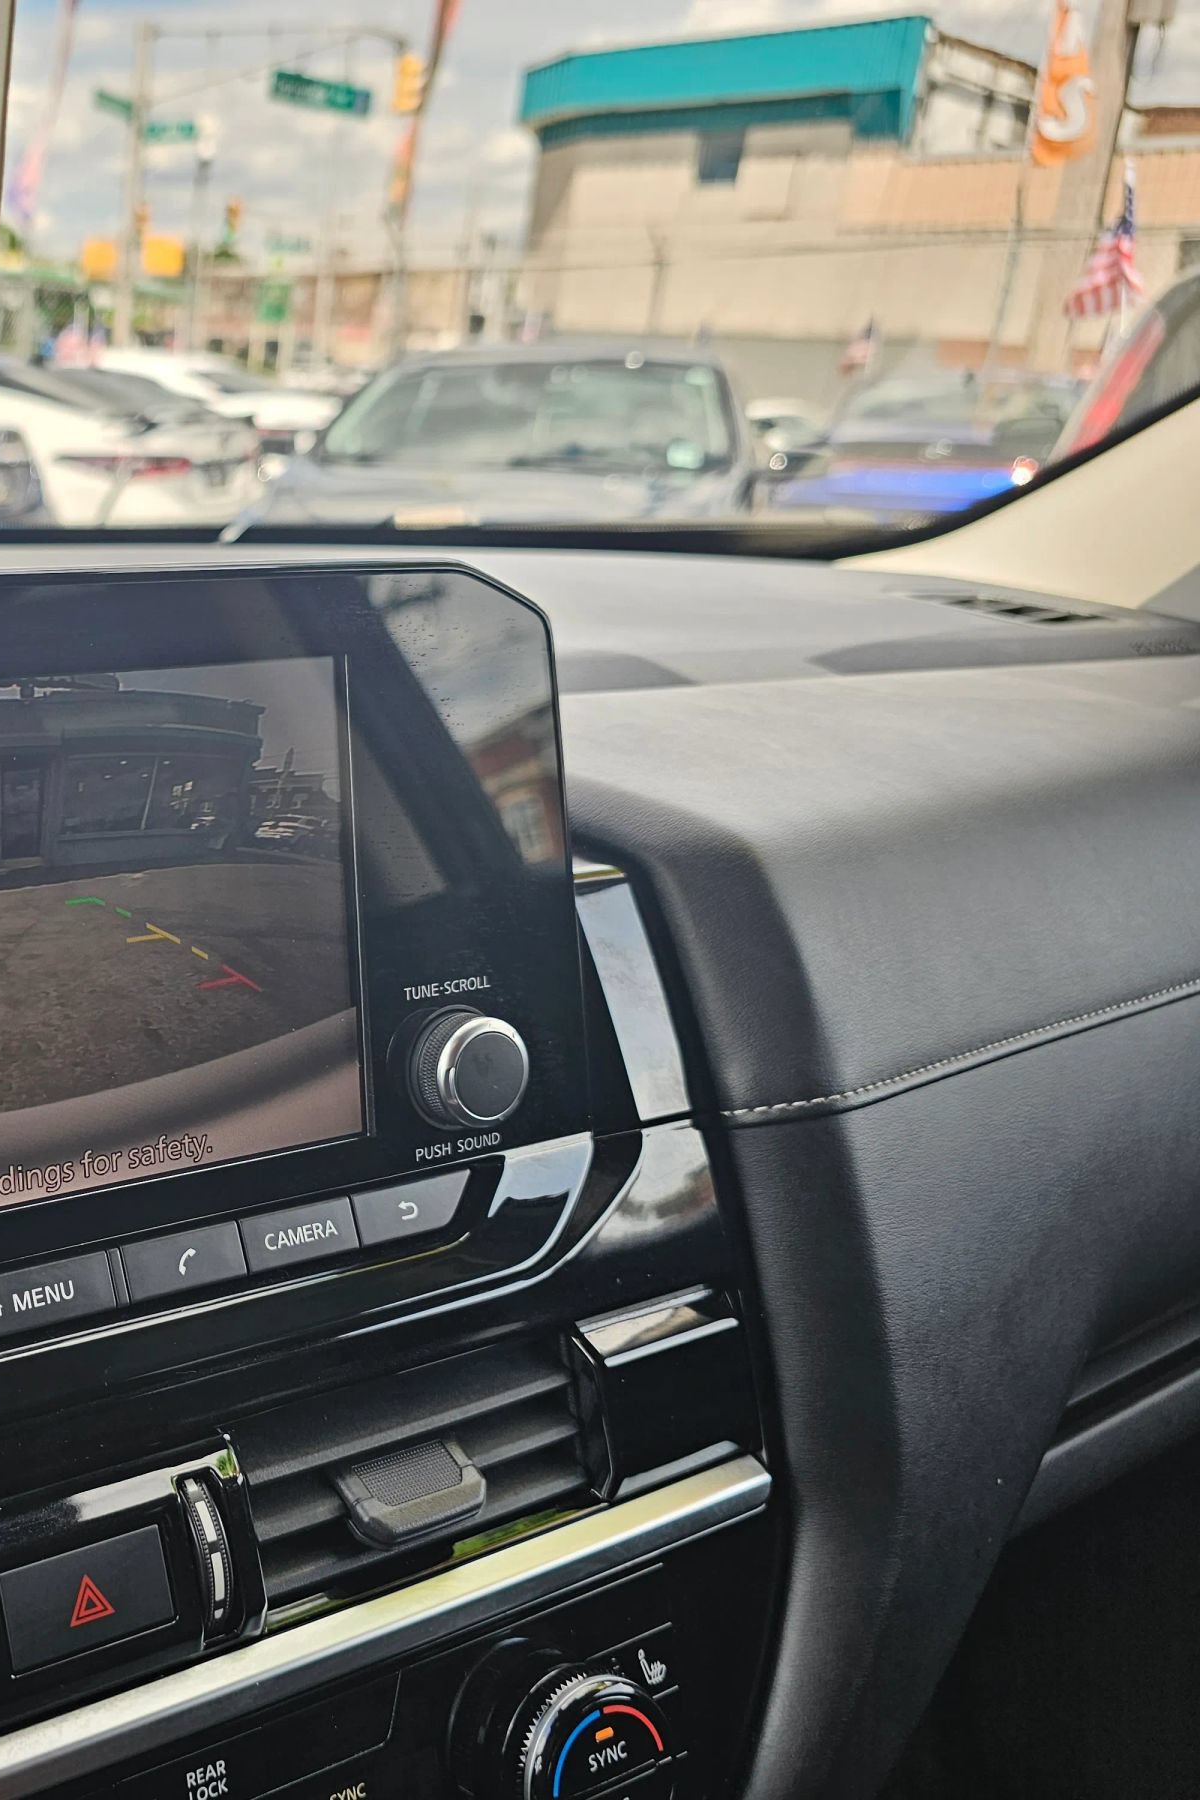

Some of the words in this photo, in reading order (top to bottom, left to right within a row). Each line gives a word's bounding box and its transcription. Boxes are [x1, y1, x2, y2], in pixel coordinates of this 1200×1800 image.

[403, 975, 491, 1001] TUNE-SCROLL
[79, 1149, 123, 1180] for
[127, 1132, 214, 1170] safety.
[415, 1142, 452, 1162] PUSH
[457, 1131, 501, 1154] SOUND
[263, 1218, 338, 1251] CAMERA
[11, 1278, 75, 1313] MENU
[587, 1740, 629, 1773] SYNC
[185, 1759, 227, 1789] REAR
